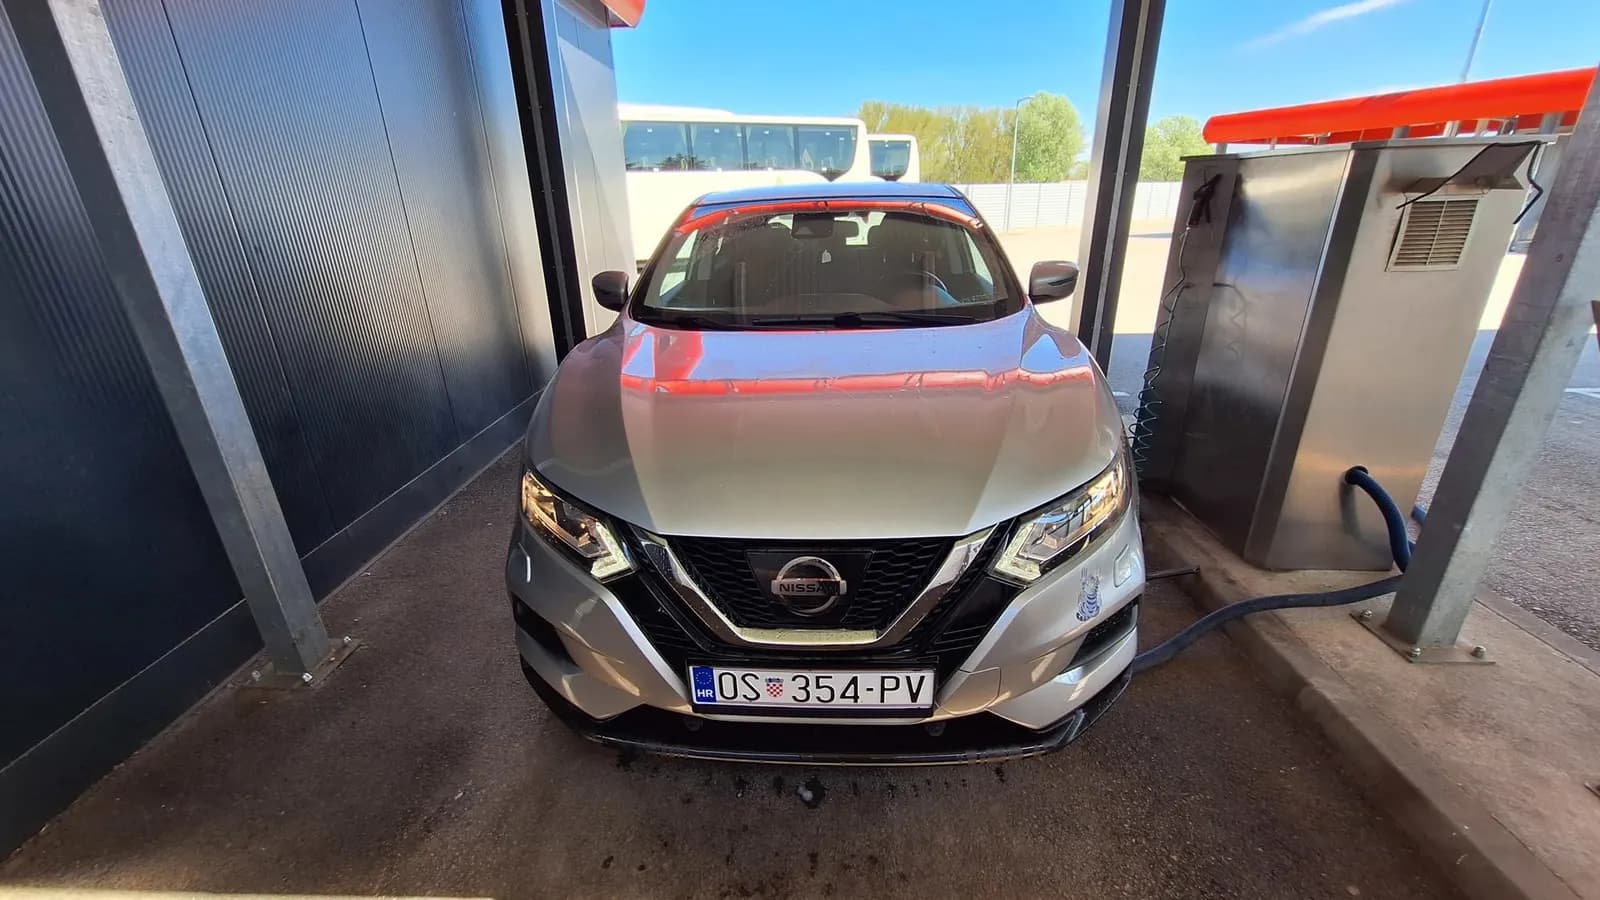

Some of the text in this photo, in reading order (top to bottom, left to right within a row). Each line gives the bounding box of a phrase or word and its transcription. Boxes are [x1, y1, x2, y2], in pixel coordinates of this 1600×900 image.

[779, 583, 838, 593] NISSAN
[697, 688, 714, 698] HR
[718, 672, 926, 704] OS 354-PV
